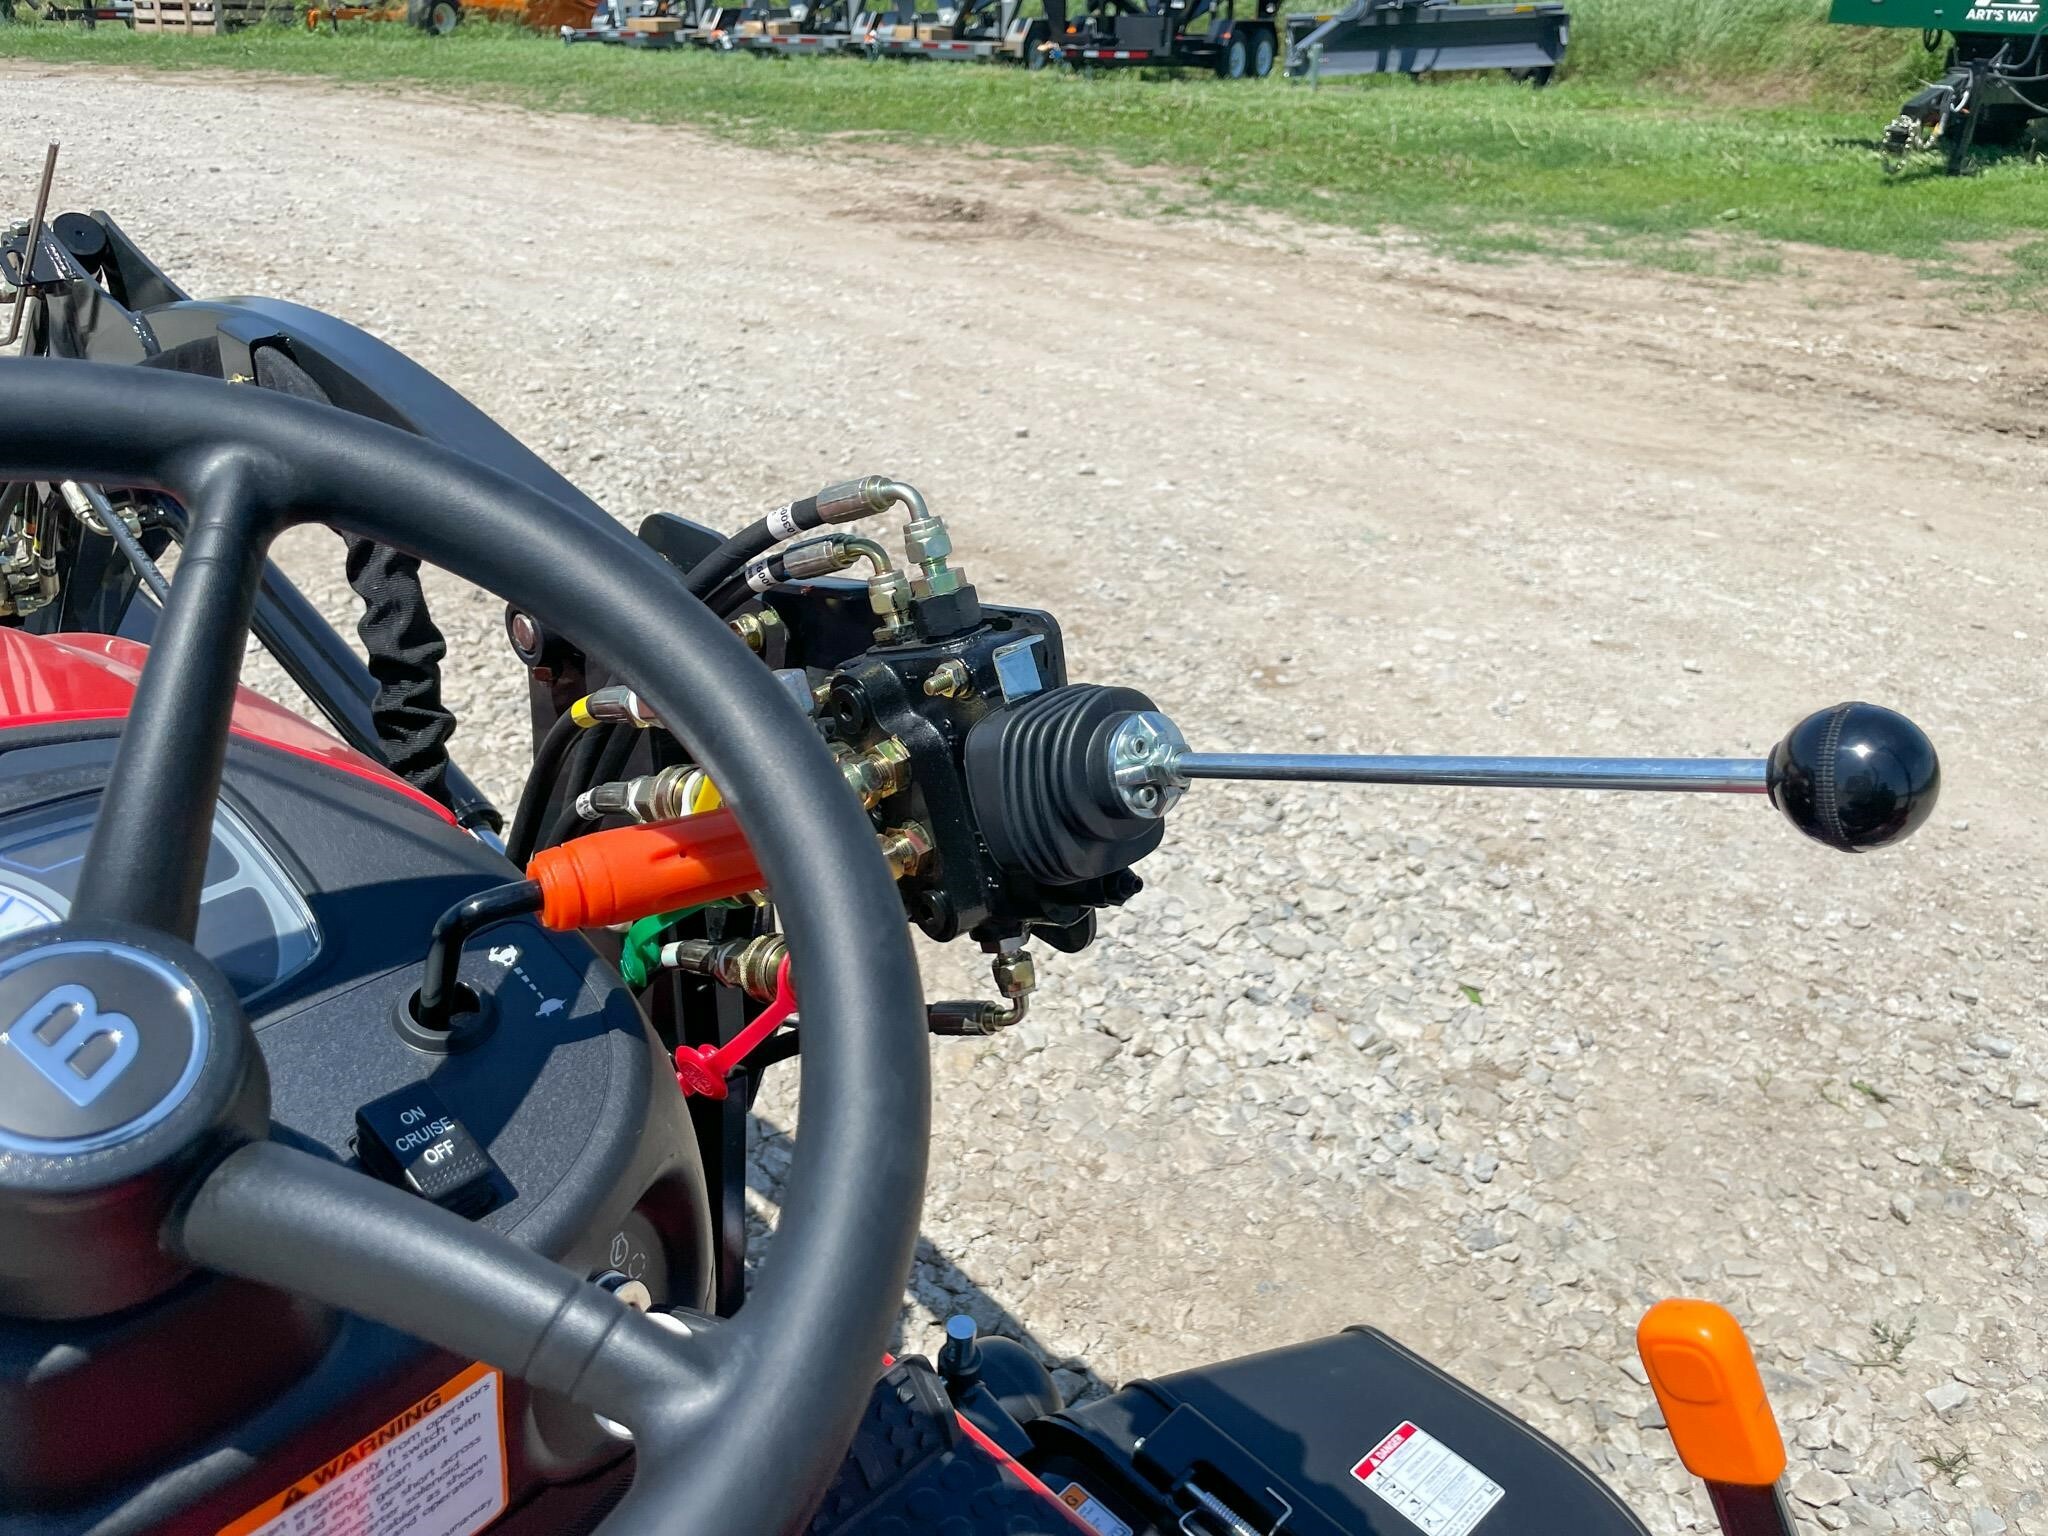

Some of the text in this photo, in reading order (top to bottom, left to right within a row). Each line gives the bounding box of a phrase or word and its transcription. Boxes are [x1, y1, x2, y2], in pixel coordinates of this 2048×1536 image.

[1966, 8, 2038, 22] ART'S WAY
[8, 983, 140, 1108] B
[395, 1116, 456, 1151] CRUISE
[400, 1106, 426, 1125] ON
[423, 1139, 455, 1163] OFF
[293, 1483, 345, 1520] engine
[349, 1459, 381, 1483] only
[387, 1431, 421, 1457] from
[425, 1382, 491, 1431] operators
[312, 1486, 358, 1521] safety
[363, 1459, 396, 1486] start
[401, 1425, 446, 1460] switch
[450, 1413, 461, 1425] is
[313, 1391, 442, 1486] WARNING
[331, 1482, 381, 1520] engine
[386, 1462, 412, 1483] can
[416, 1434, 448, 1462] start
[452, 1411, 481, 1436] with
[401, 1467, 435, 1496] short
[440, 1435, 482, 1470] across
[1375, 1432, 1407, 1462] DANGER
